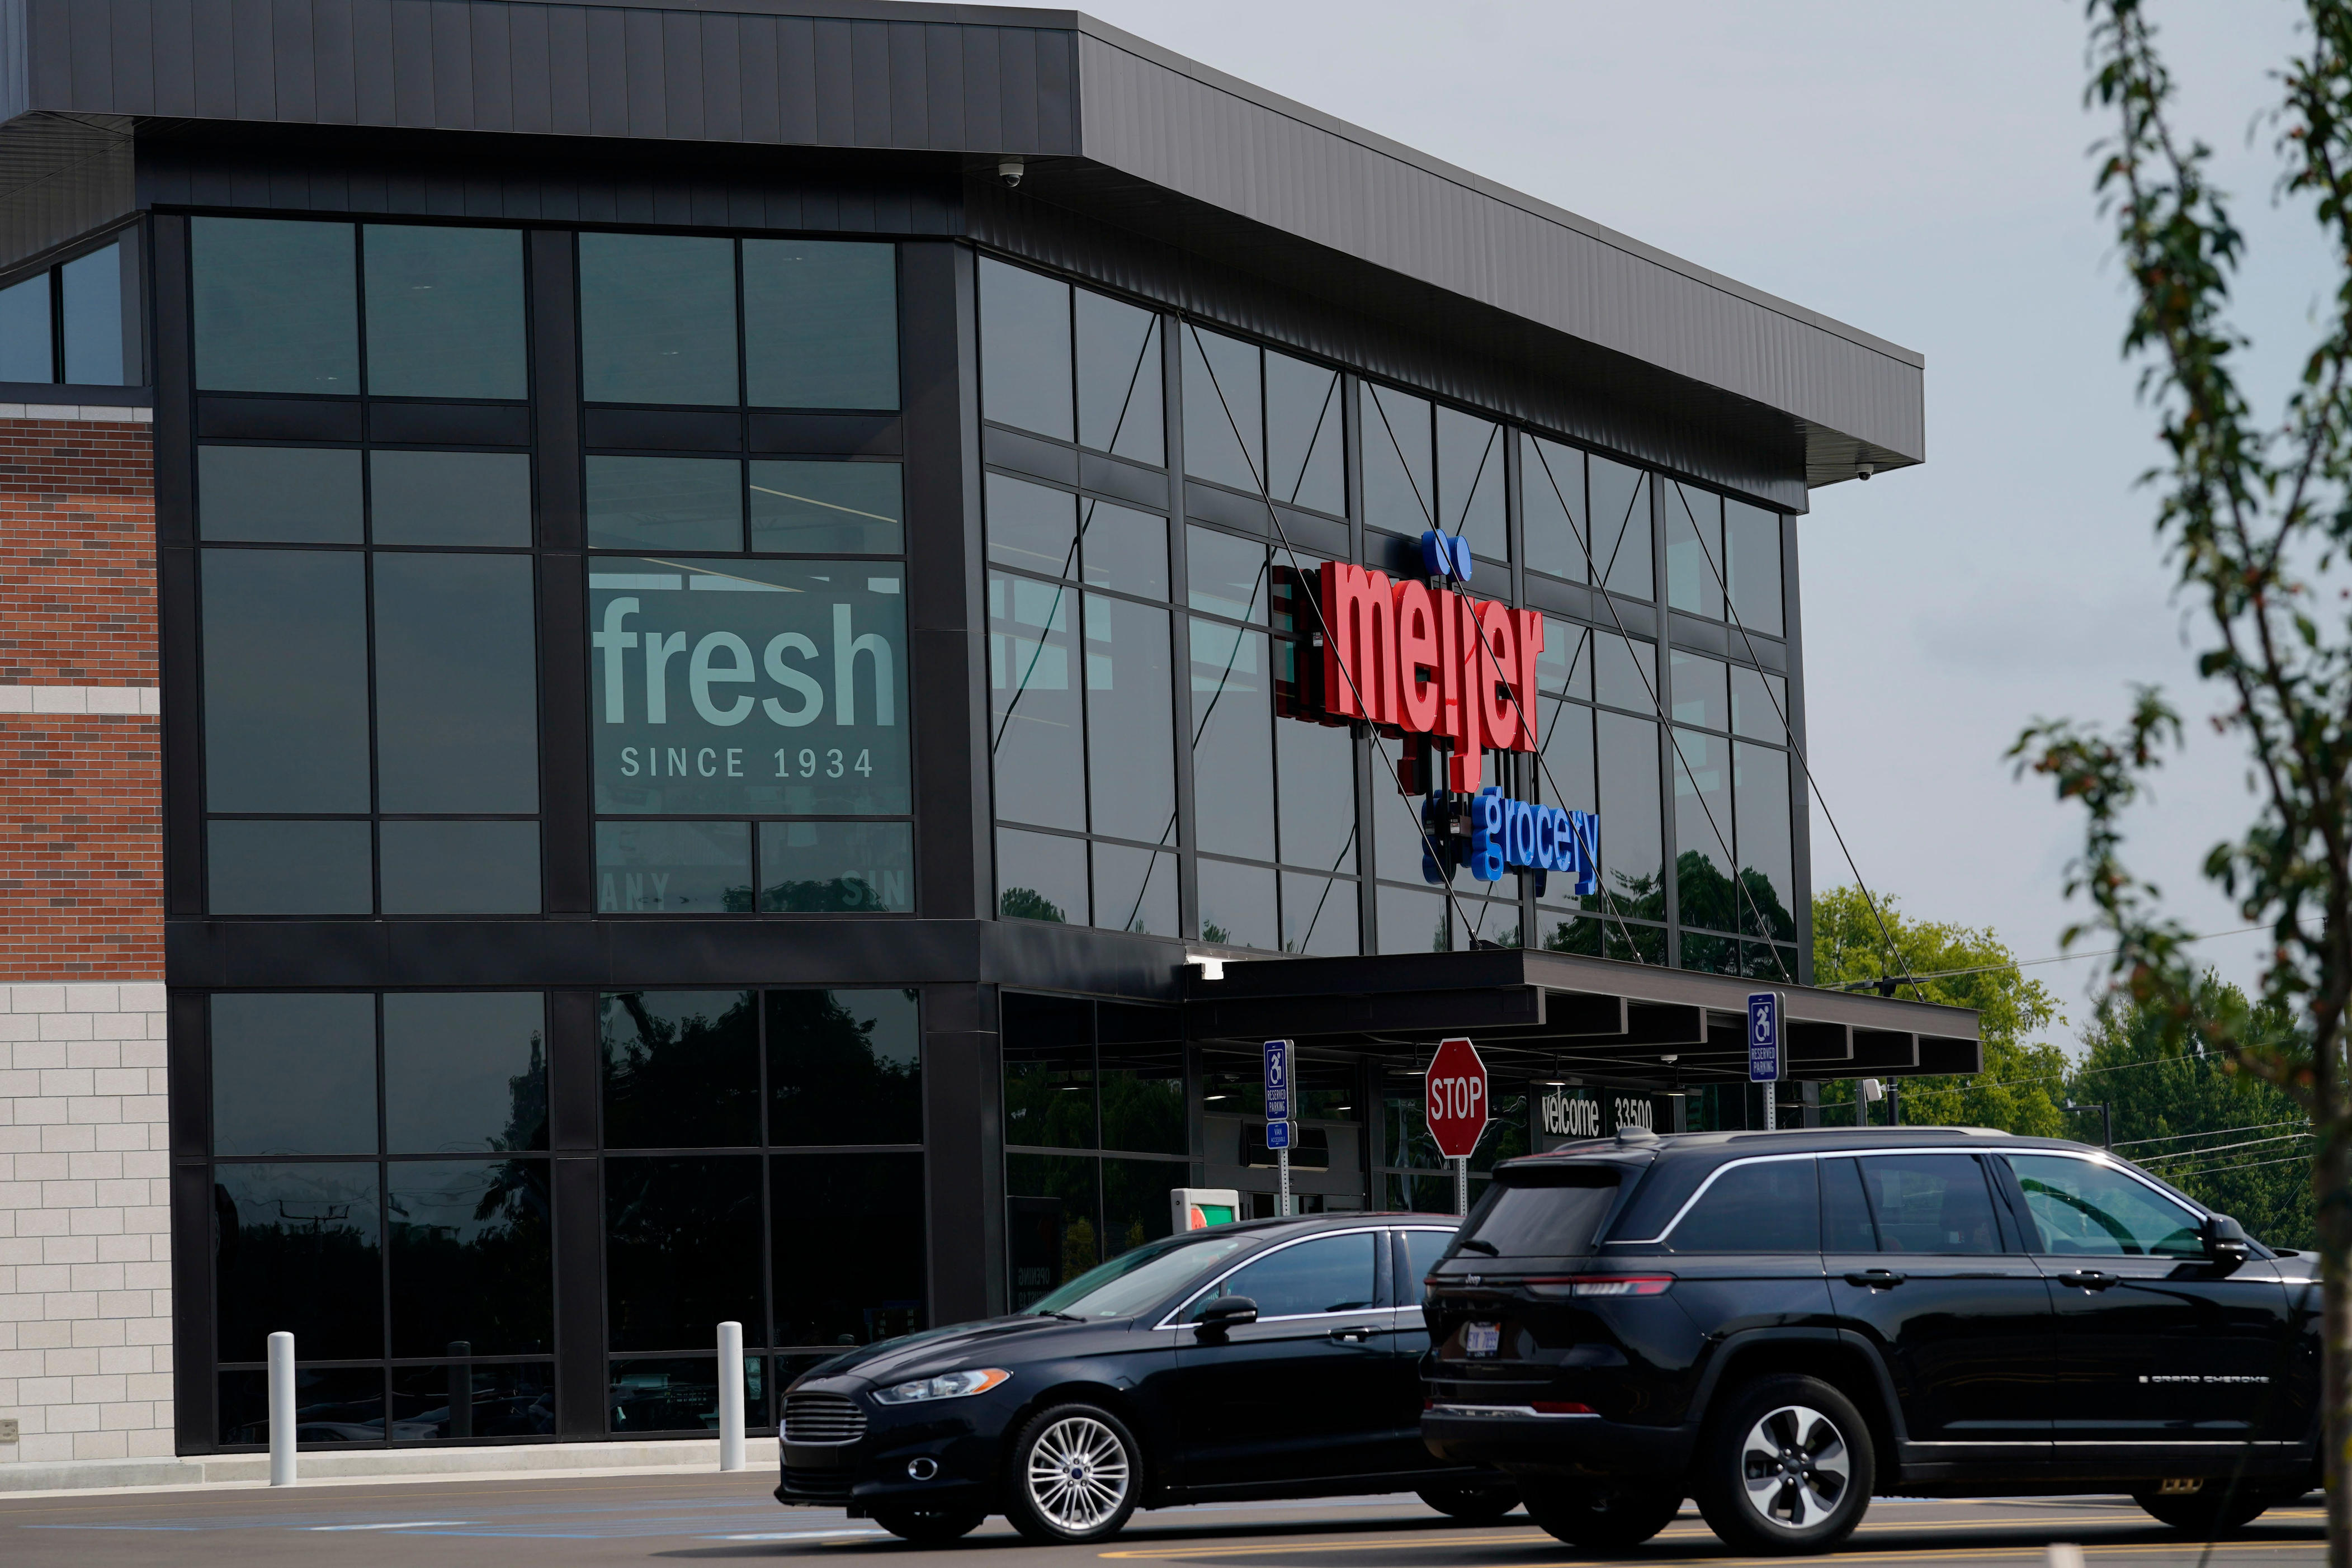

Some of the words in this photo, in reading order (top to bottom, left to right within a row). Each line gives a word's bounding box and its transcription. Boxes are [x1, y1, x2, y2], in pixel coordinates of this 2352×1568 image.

[592, 596, 895, 727] fresh
[1321, 528, 1545, 794] meijer
[620, 747, 744, 777] SINCE
[774, 748, 872, 778] 1934
[1472, 786, 1599, 895] grocery
[1751, 1047, 1775, 1060] RESERVED
[1753, 1060, 1774, 1073] PARKING
[1267, 1089, 1286, 1101] RESERVED
[1269, 1101, 1285, 1112] PARKING
[1431, 1076, 1482, 1120] STOP
[1615, 1097, 1652, 1132] 33500
[2151, 1375, 2200, 1383] GRAND
[2203, 1375, 2270, 1383] CHEROKE
